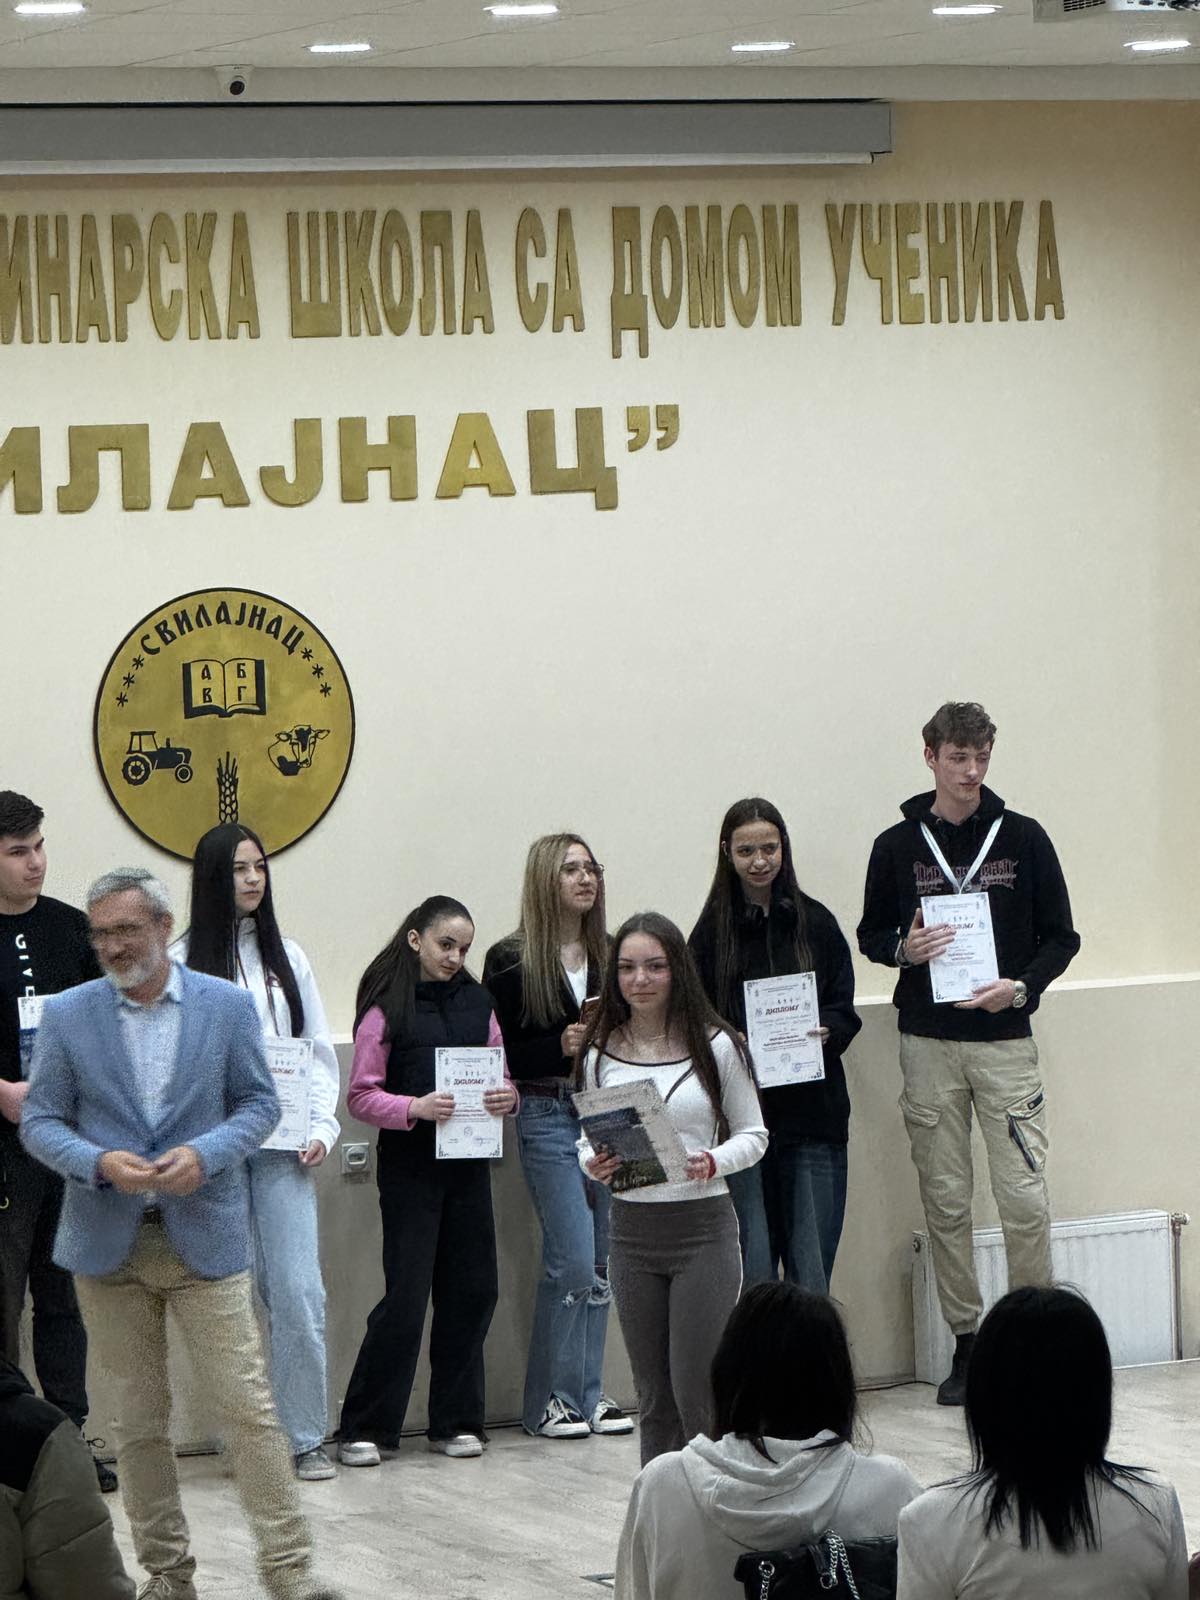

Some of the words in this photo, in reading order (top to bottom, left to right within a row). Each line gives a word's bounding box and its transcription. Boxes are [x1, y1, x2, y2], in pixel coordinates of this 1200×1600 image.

[287, 208, 495, 338] ШКОЛА
[515, 206, 586, 332] СА
[611, 203, 801, 359] ДОМОМ
[825, 199, 1065, 326] УЧЕНИКА
[140, 601, 305, 656] СВИЛАЈНАЦ
[201, 664, 212, 680] А
[236, 663, 247, 678] Б
[202, 687, 213, 703] В
[237, 686, 248, 702] Г
